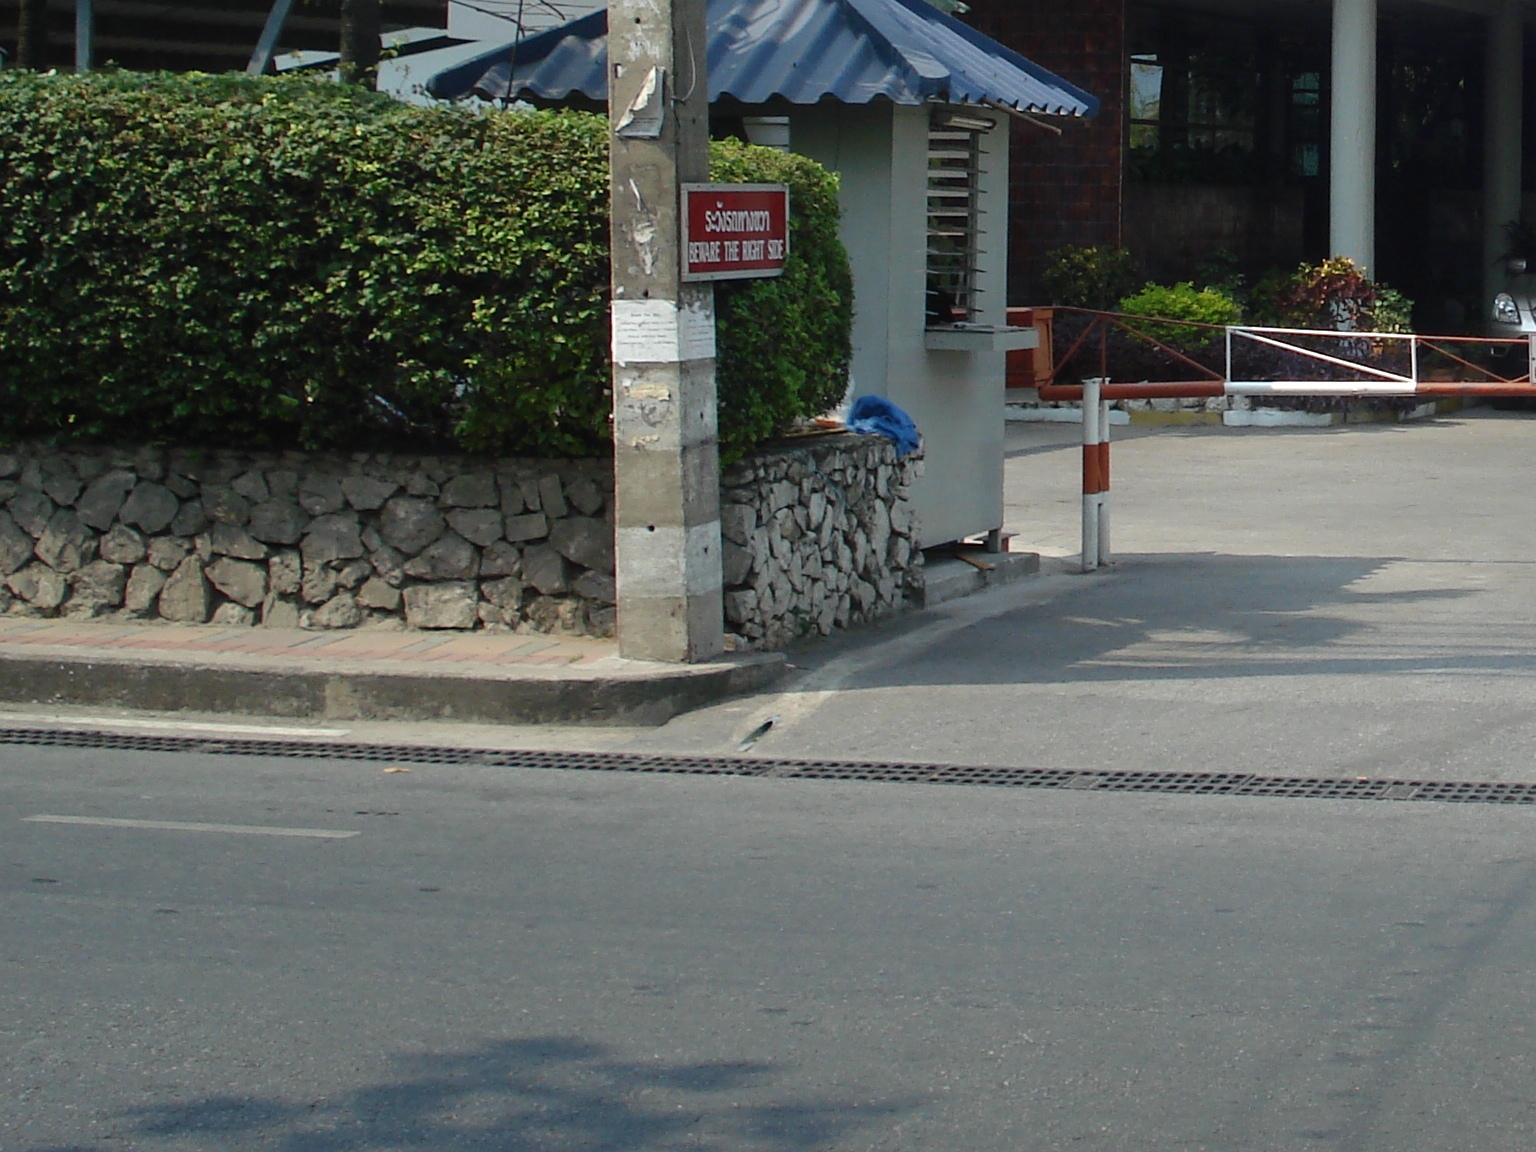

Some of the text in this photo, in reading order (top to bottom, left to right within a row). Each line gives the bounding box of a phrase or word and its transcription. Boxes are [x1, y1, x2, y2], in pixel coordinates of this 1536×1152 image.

[689, 239, 784, 263] BEWARE THE RIGHT SIDE
